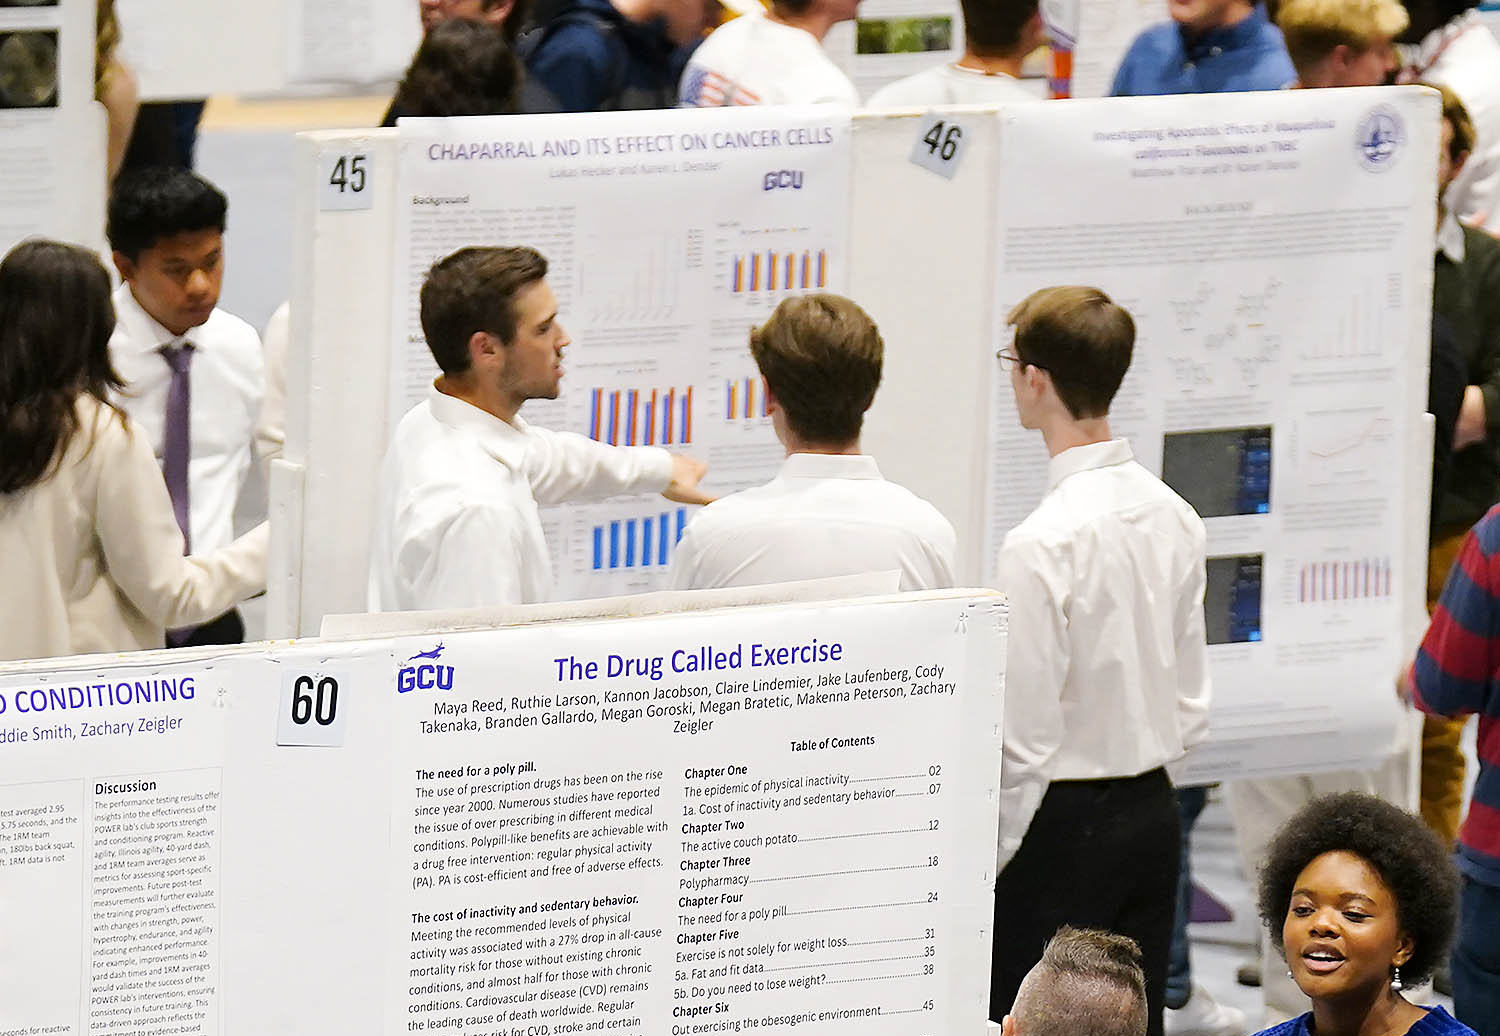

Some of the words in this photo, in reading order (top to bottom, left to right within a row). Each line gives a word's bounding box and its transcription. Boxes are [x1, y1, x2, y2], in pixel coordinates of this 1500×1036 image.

[428, 140, 537, 160] CHAPARRAL
[543, 138, 580, 157] AND
[586, 138, 611, 155] ITS
[616, 135, 674, 154] EFFECT
[680, 133, 706, 150] ON
[714, 129, 782, 149] CANCER
[786, 127, 833, 145] CELLS
[921, 119, 962, 162] 46
[330, 155, 366, 194] 45
[762, 170, 803, 190] GCU
[554, 656, 598, 681] The
[607, 654, 663, 680] Drug
[671, 645, 742, 673] Called
[751, 639, 843, 667] Exercise
[398, 665, 454, 693] GCU
[434, 703, 468, 716] Maya
[472, 701, 507, 713] Reed,
[511, 698, 551, 710] Ruthie
[556, 694, 600, 707] Larson,
[604, 690, 650, 703] Kannon
[652, 685, 712, 700] Jacobson,
[715, 681, 749, 695] Claire
[753, 677, 813, 692] Lindemier,
[817, 674, 841, 687] Jake
[845, 668, 911, 684] Laufenberg,
[915, 664, 944, 680] Cody
[15, 677, 195, 713] CONDITIONING
[291, 675, 338, 726] 60
[420, 719, 481, 734] Takenaka,
[485, 715, 538, 730] Branden
[541, 710, 598, 726] Gallardo,
[601, 708, 643, 723] Megan
[646, 701, 696, 718] Goroski,
[700, 700, 741, 715] Megan
[744, 696, 793, 710] Bratetic,
[797, 691, 850, 706] Makenna
[854, 686, 907, 701] Peterson,
[910, 681, 956, 696] Zachary
[33, 724, 76, 741] Smith,
[81, 721, 134, 737] Zachary
[138, 716, 183, 733] Zeigler
[673, 719, 714, 735] Zeigler
[790, 740, 817, 752] Table
[820, 738, 830, 749] of
[832, 735, 875, 748] Contents
[416, 770, 435, 781] The
[438, 768, 463, 779] need
[467, 766, 481, 776] for
[493, 764, 515, 776] poly
[518, 762, 537, 773] pill.
[685, 767, 725, 780] Chapter
[728, 765, 748, 776] One
[95, 780, 156, 795] Discussion
[684, 786, 702, 797] The
[705, 782, 749, 796] epidemic
[752, 780, 761, 791] of
[764, 777, 803, 792] physical
[109, 799, 154, 809] performance
[156, 796, 179, 804] testing
[181, 793, 203, 801] results
